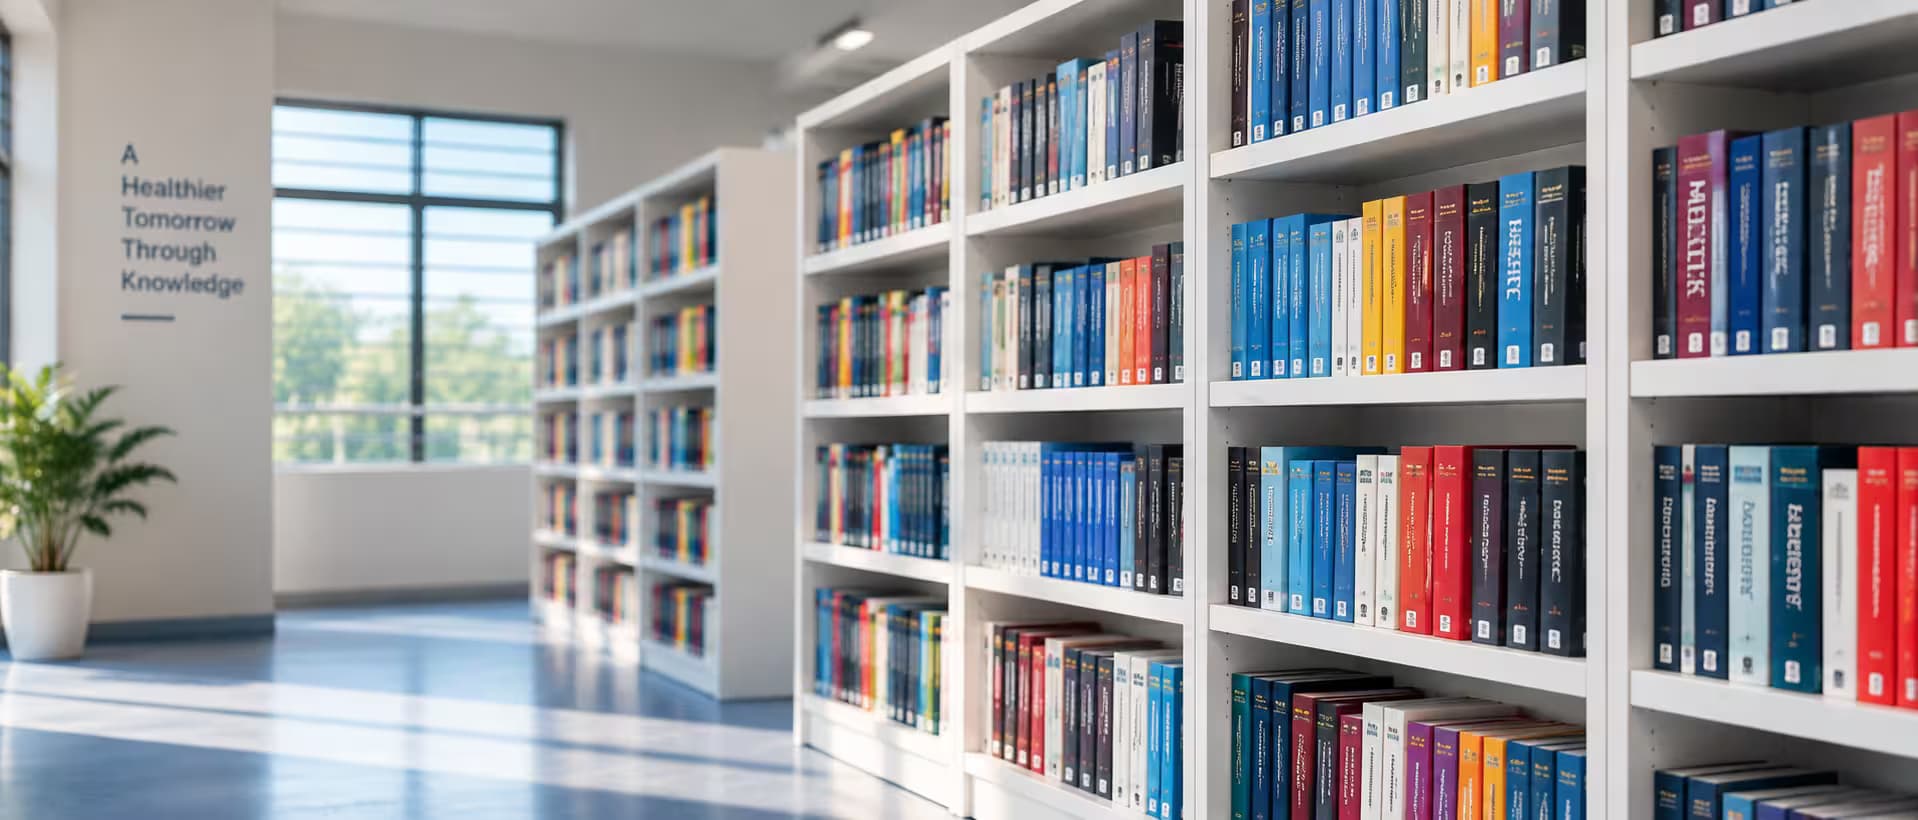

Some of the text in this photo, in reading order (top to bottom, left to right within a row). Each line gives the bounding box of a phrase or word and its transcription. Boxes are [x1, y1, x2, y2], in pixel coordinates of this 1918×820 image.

[121, 143, 139, 165] A
[121, 175, 227, 200] Healthier
[122, 206, 236, 232] Tomorrow
[122, 238, 216, 266] Through
[121, 270, 245, 299] Knowledge
